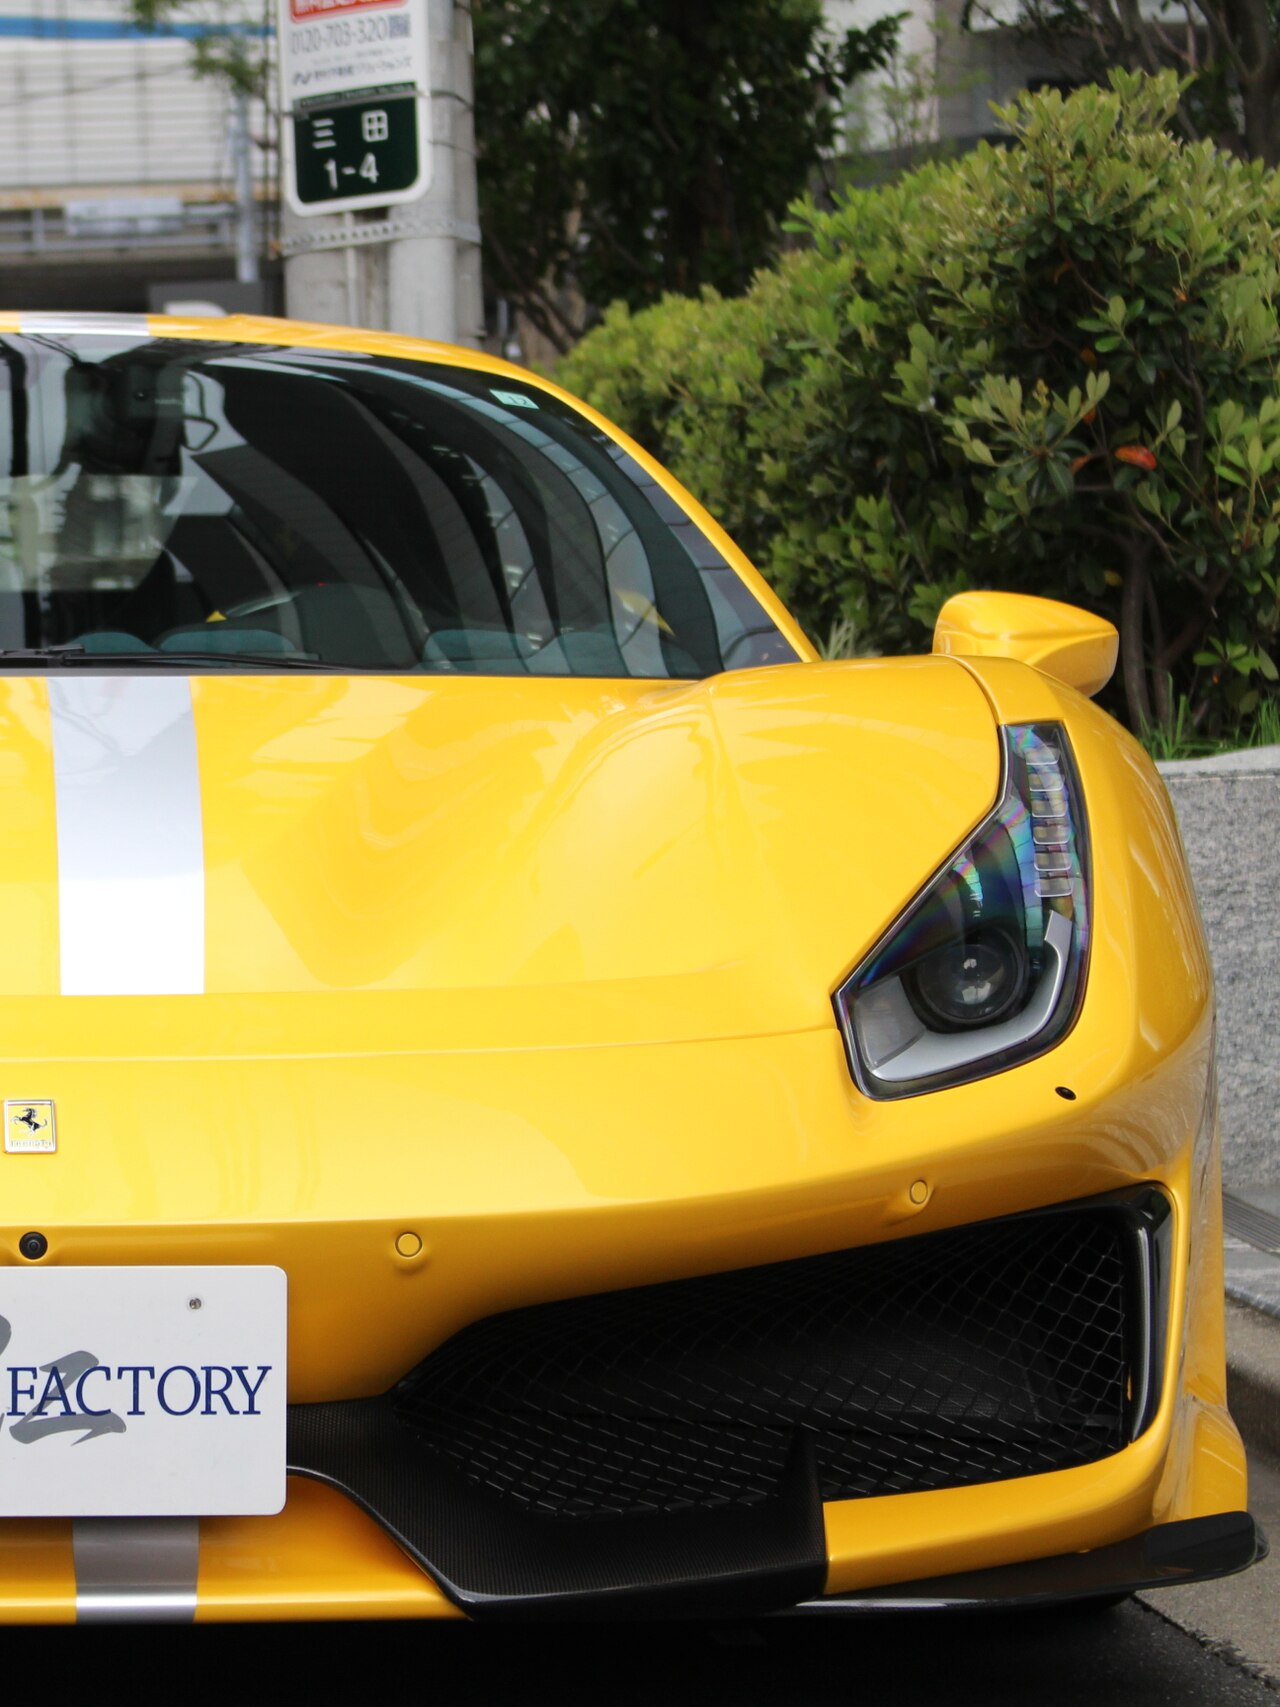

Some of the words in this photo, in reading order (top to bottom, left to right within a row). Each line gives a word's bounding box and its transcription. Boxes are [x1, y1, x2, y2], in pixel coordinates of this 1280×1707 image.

[312, 109, 389, 149] 三田
[324, 152, 380, 190] 1-4
[5, 1364, 273, 1417] FACTORY
